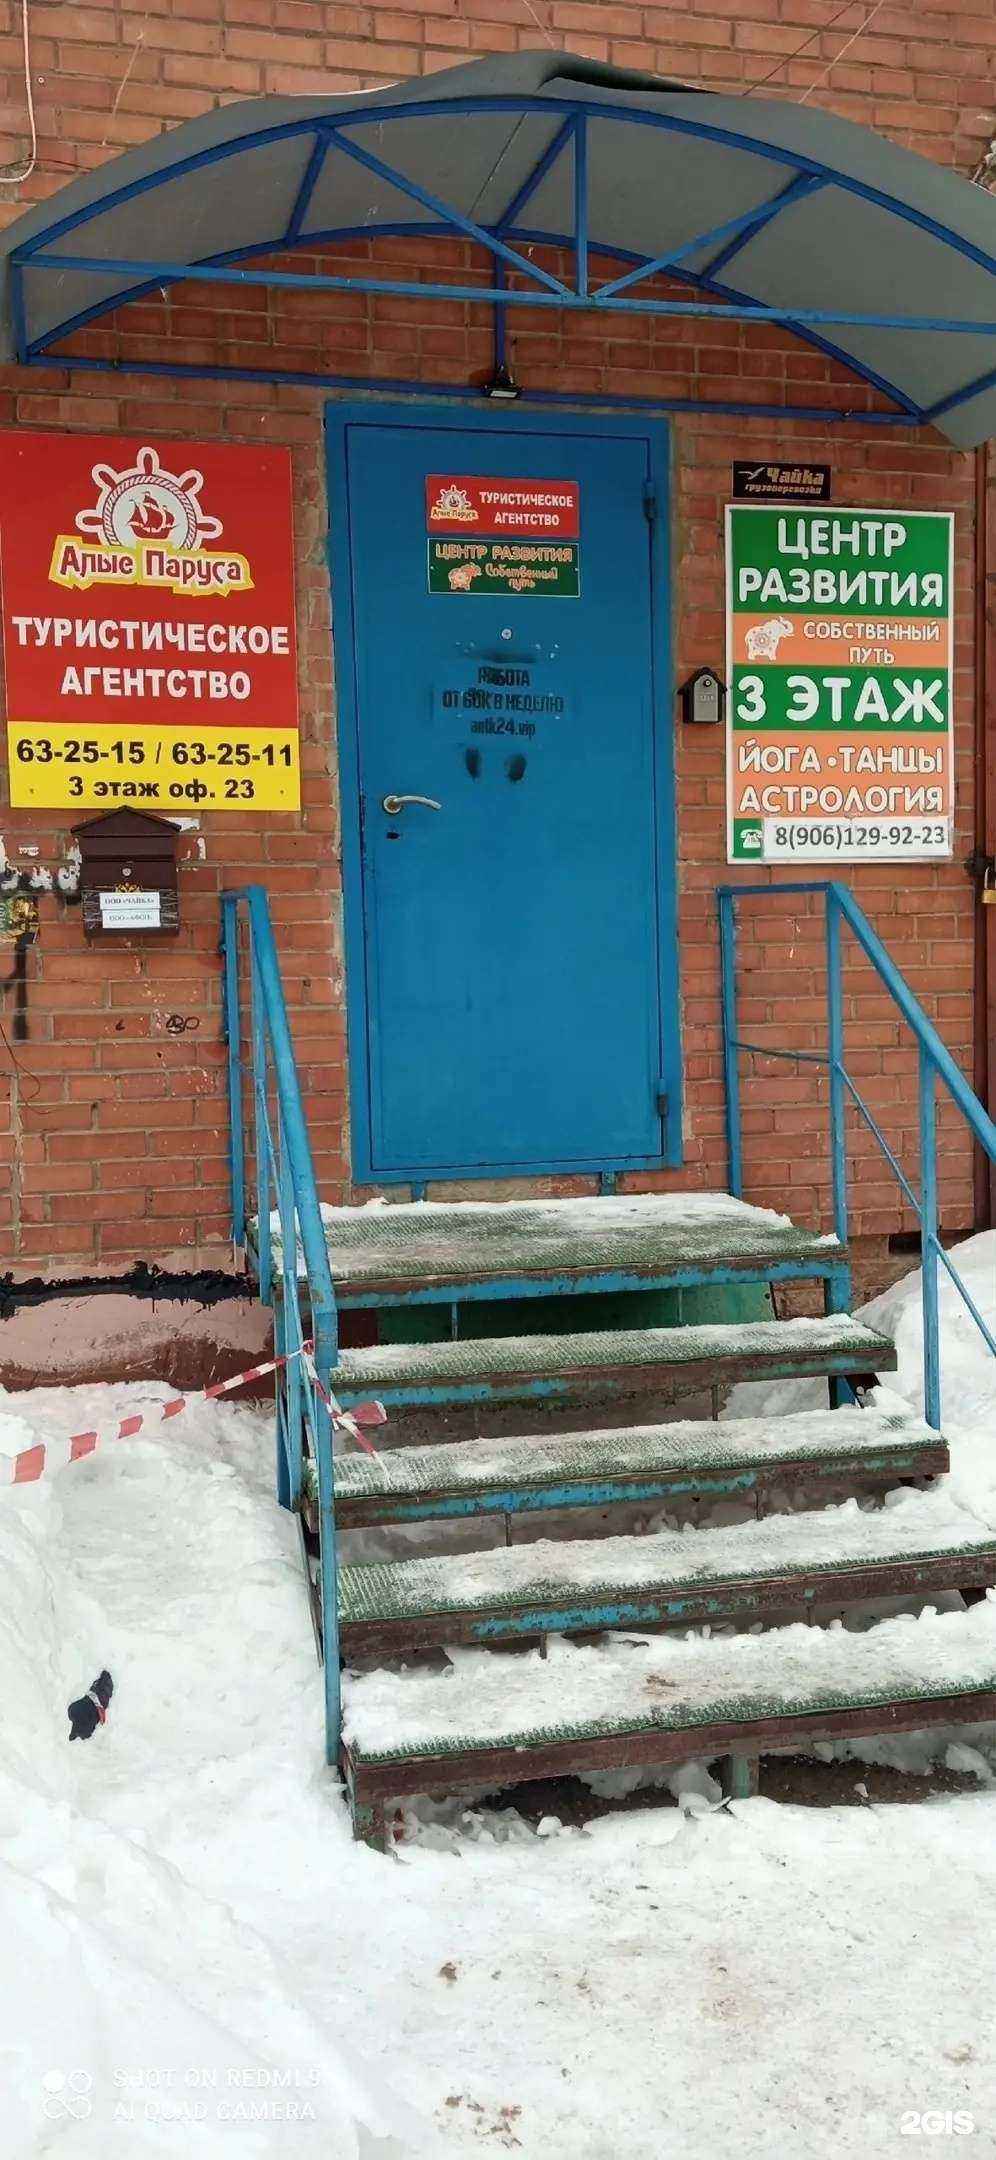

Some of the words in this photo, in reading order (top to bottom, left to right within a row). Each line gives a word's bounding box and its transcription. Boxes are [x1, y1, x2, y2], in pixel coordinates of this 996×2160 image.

[767, 467, 825, 485] Чайка
[479, 491, 574, 508] ТУРИСТИЧЕСКОЕ
[494, 511, 560, 526] АГЕНТСТВО
[435, 543, 488, 561] ЦЕНТР
[492, 545, 573, 563] РАЗВИТИЯ
[777, 518, 906, 560] ЦЕНТР
[59, 547, 134, 578] Алые
[146, 550, 241, 586] Паруса
[738, 567, 944, 608] РАЗВИТИЯ
[12, 616, 290, 655] ТУРИСТИЧЕСКОЕ
[803, 620, 940, 643] СОБСТВЕННЫЙ
[848, 645, 896, 665] ПУТЬ
[60, 666, 251, 700] АГЕНТСТВО
[737, 675, 767, 722] 3
[786, 676, 945, 723] ЭТАЖ
[16, 739, 146, 765] 63-25-15
[172, 742, 292, 767] 63-25-11
[738, 739, 822, 774] ЙОГА
[839, 746, 943, 776] ТАНЦЫ
[68, 775, 84, 797] 3
[94, 780, 160, 799] этаж
[168, 777, 216, 802] оф.
[224, 779, 256, 799] 23
[738, 785, 944, 814] АСТРОЛОГИЯ
[775, 826, 945, 850] 8(906)129-92-23
